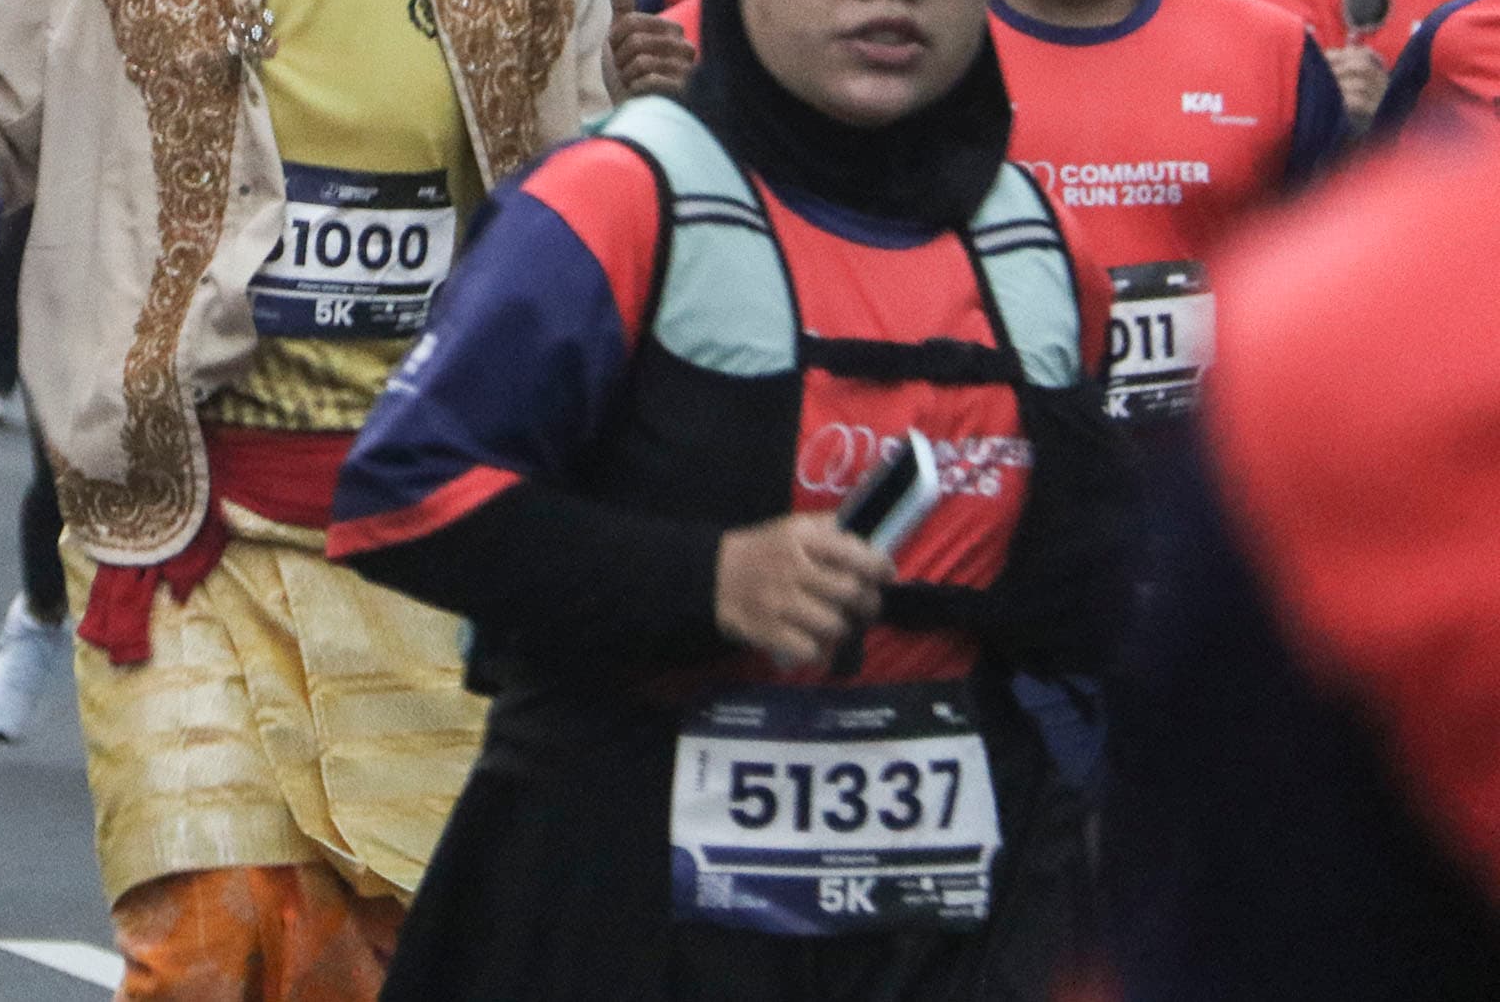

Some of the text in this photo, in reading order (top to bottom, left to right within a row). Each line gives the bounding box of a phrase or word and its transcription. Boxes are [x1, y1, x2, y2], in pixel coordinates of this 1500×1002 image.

[1059, 161, 1211, 184] COMMUTER
[1063, 187, 1118, 206] RUN
[263, 219, 429, 271] 1000
[314, 298, 355, 327] 5K
[728, 760, 960, 832] 51337
[819, 877, 878, 914] 5K
